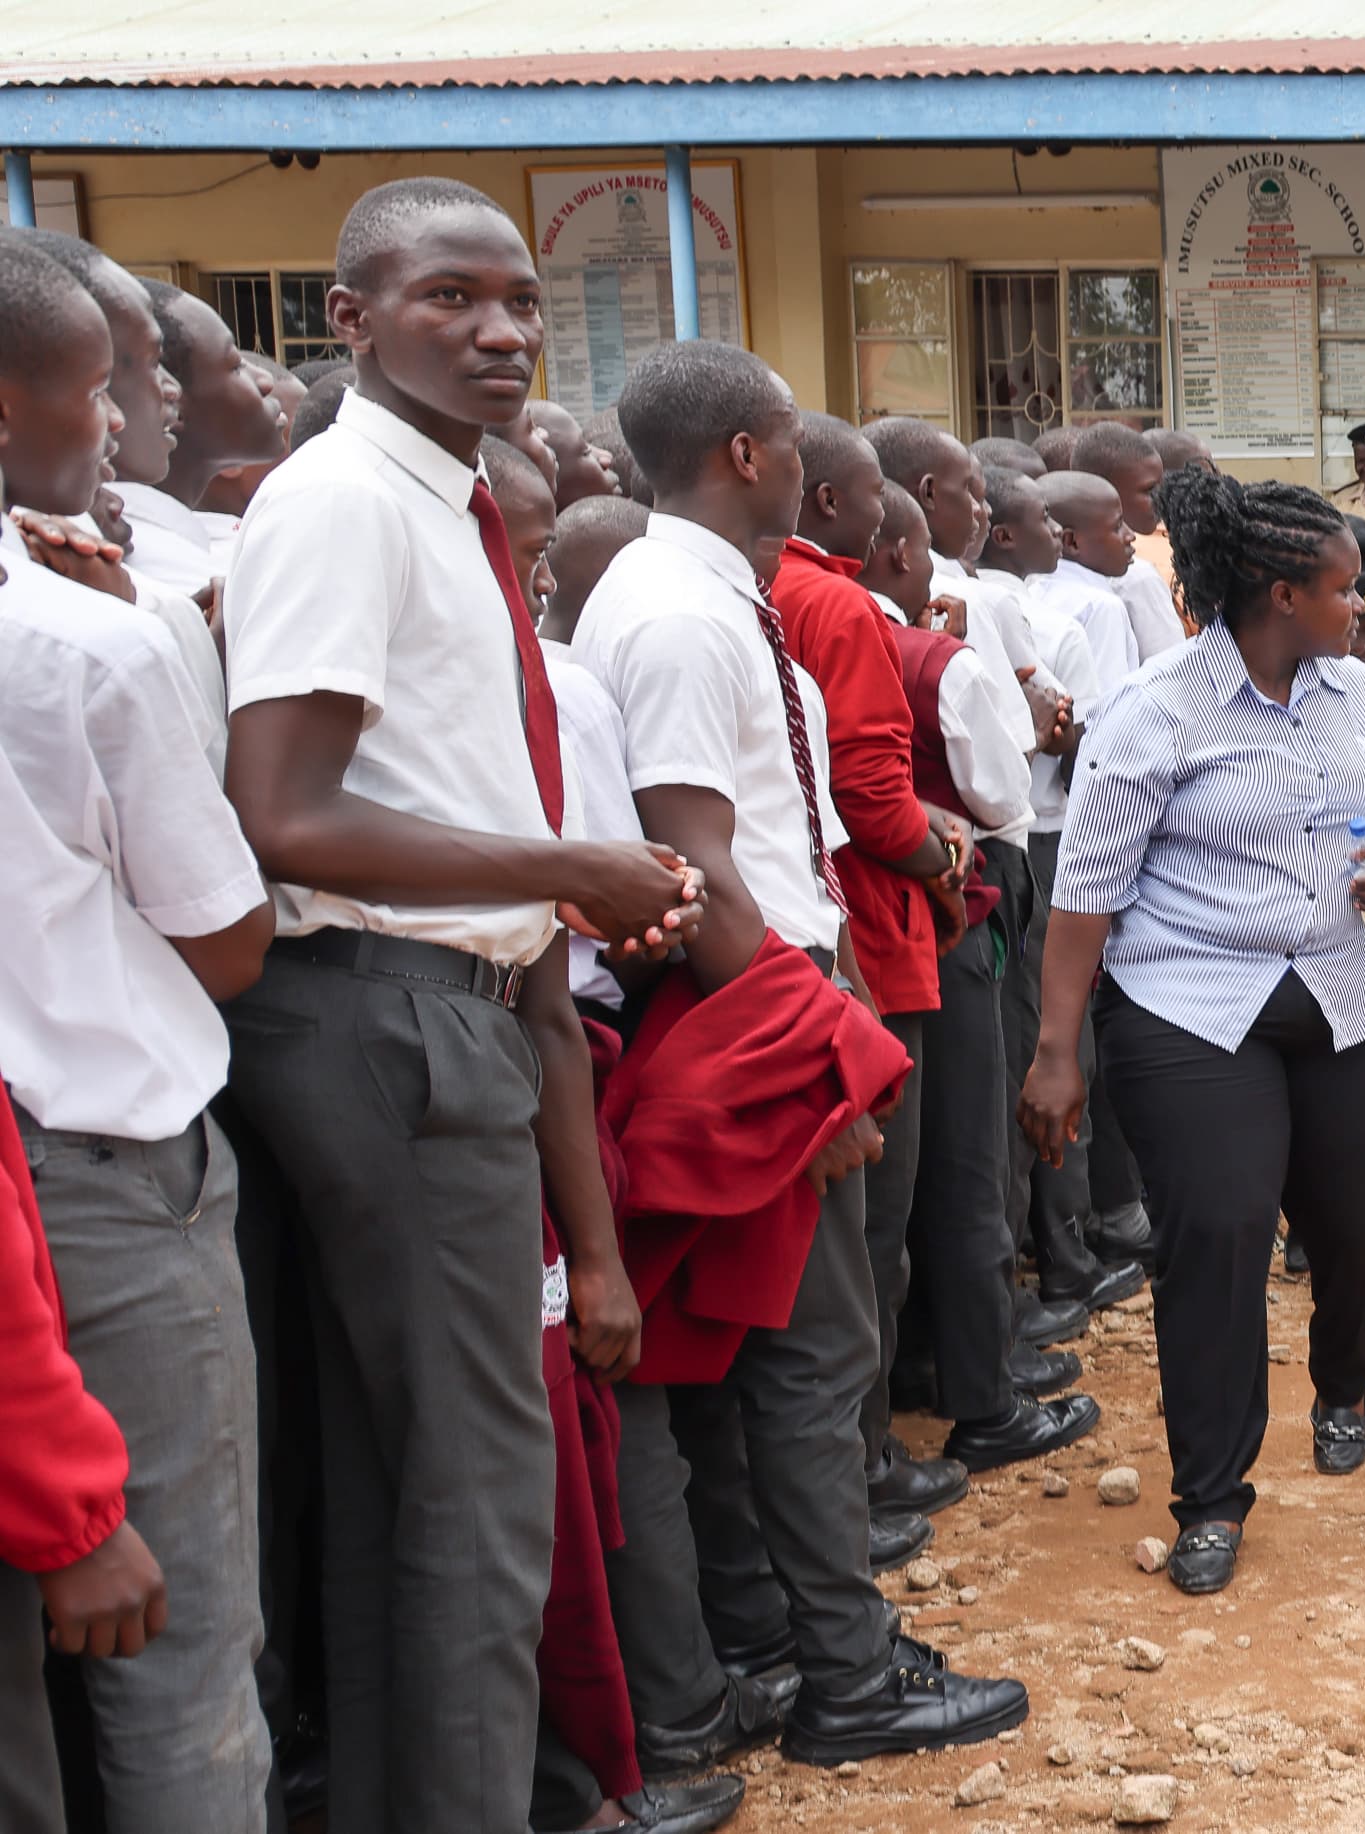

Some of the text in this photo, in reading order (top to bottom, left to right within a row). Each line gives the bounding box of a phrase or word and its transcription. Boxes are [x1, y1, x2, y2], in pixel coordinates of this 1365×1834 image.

[541, 216, 565, 256] SHULE
[559, 201, 576, 218] YA
[573, 181, 605, 207] UPILI
[607, 176, 622, 192] YA
[625, 175, 668, 193] MSETO
[691, 194, 733, 251] MUSUTSU
[1178, 172, 1225, 274] IMUSUTSU
[1226, 151, 1284, 178] MIXED
[1288, 156, 1323, 188] SEC.
[1324, 182, 1365, 254] SCHOO
